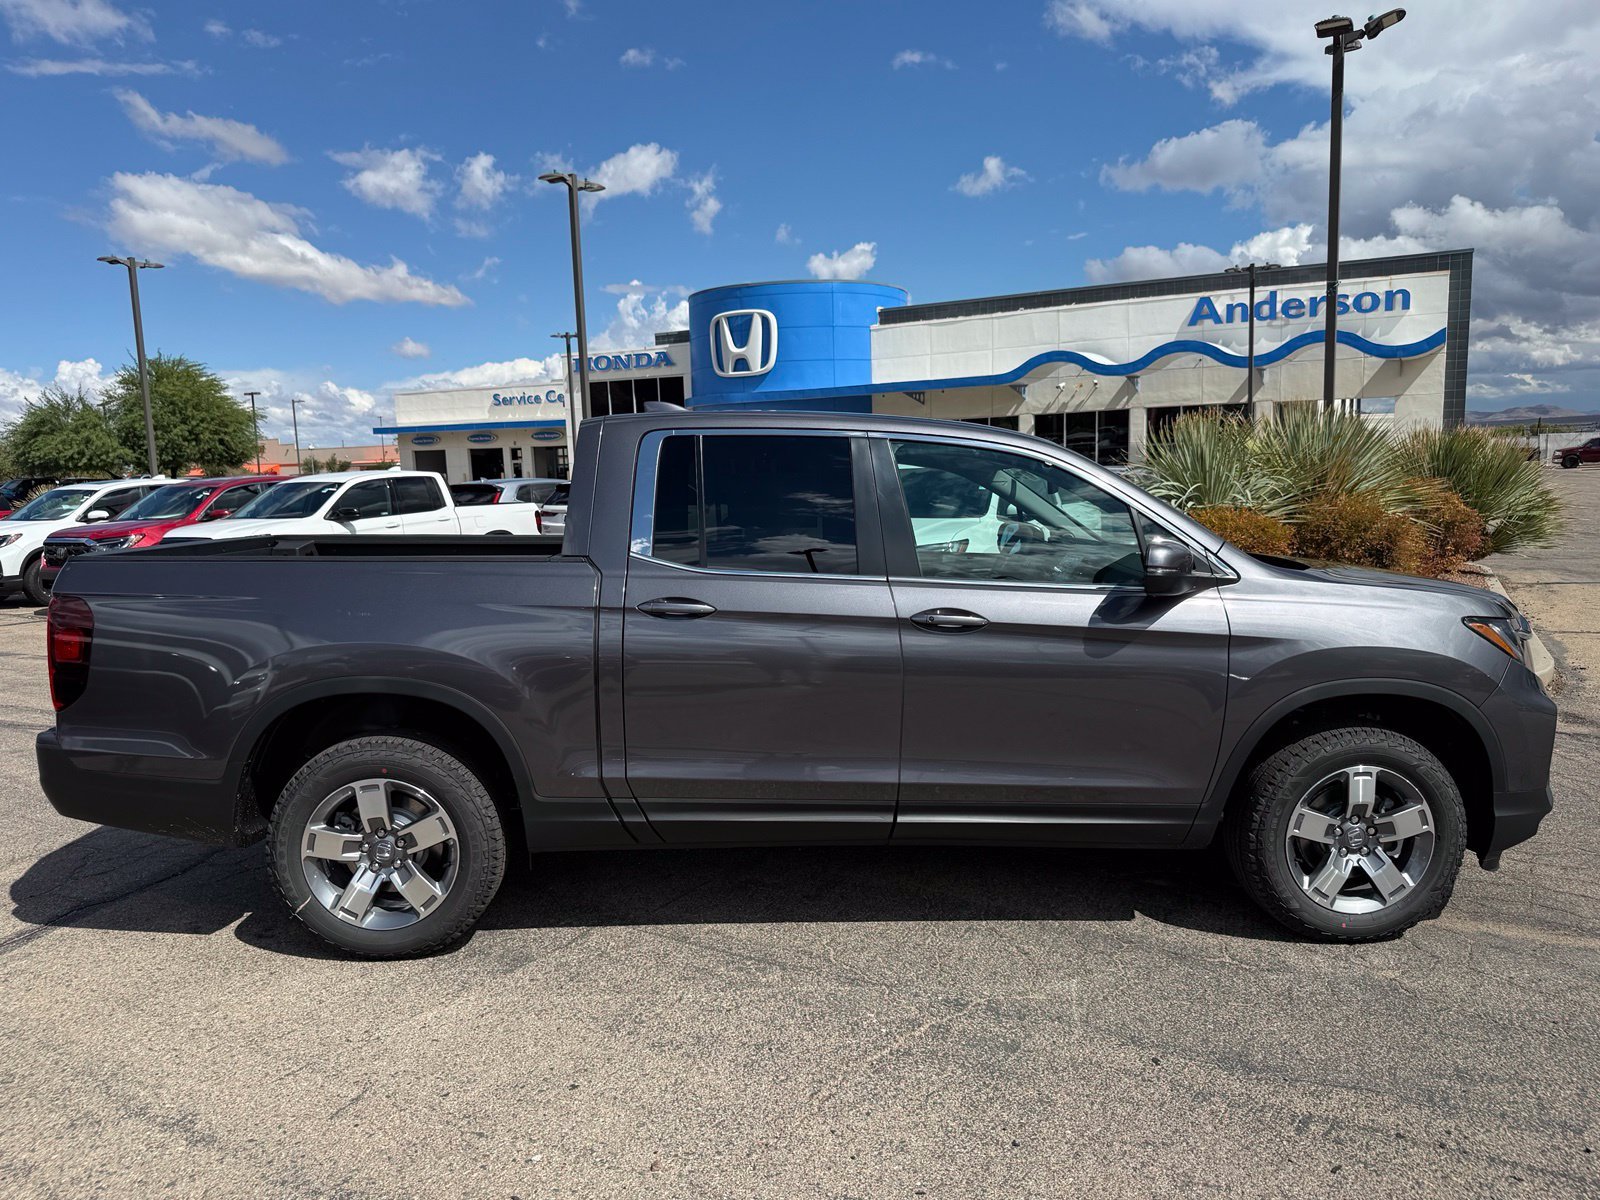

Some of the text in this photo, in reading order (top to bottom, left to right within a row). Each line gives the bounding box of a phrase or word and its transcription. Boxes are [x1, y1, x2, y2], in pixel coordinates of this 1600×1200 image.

[1187, 288, 1411, 326] Anderson
[492, 389, 566, 408] Service Ce
